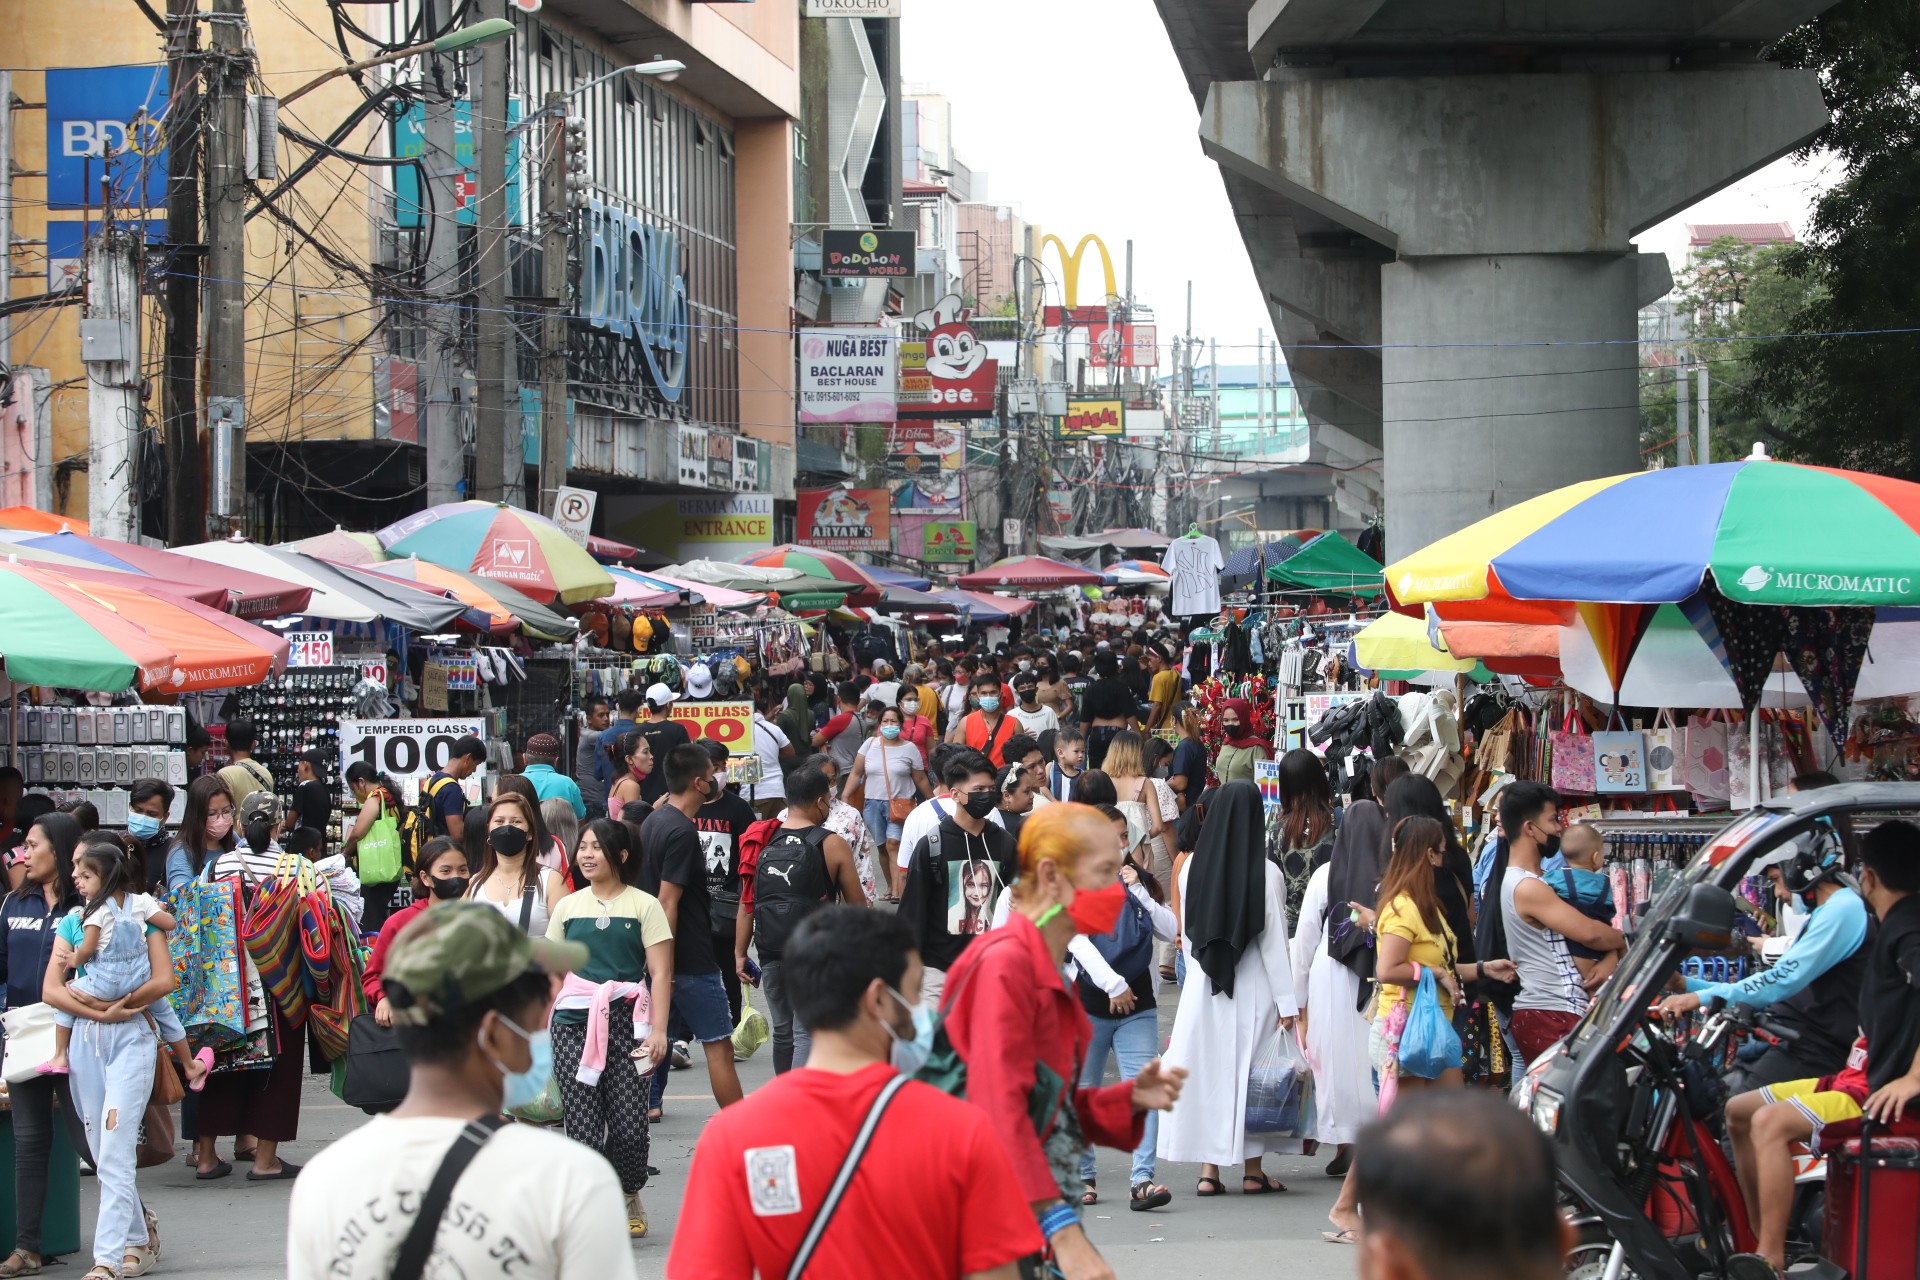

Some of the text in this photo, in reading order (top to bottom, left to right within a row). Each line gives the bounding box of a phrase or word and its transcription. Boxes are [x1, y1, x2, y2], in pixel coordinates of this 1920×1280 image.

[62, 119, 167, 157] BDO
[867, 266, 908, 275] WORLD
[826, 340, 888, 357] NUGA BEST
[1137, 339, 1151, 349] 24
[810, 366, 884, 377] BACLARAN
[817, 378, 877, 386] BEST HOUSE
[804, 392, 860, 402] Tel: 0915-601-6092
[904, 427, 932, 441] Ribbon
[679, 499, 770, 514] BERMA MALL
[556, 519, 567, 527] NO
[684, 520, 766, 536] ENTRANCE
[560, 527, 585, 538] ARKING
[811, 526, 873, 538] ARYAN'S
[477, 566, 518, 579] AMERICAN
[1011, 576, 1061, 584] MICROMATIC
[1775, 572, 1911, 594] MICROMATIC
[239, 595, 280, 615] MICROMATIC
[800, 598, 840, 607] MICROMATIC
[292, 633, 329, 642] RELO
[691, 636, 715, 647] 50
[288, 642, 298, 665] 2
[302, 641, 332, 665] 150
[188, 663, 256, 682] MICROMATIC
[447, 665, 475, 684] 80
[704, 706, 750, 718] GLASS
[356, 725, 468, 735] TEMPERED GLASS
[350, 735, 460, 774] 100
[1624, 772, 1640, 786] 23
